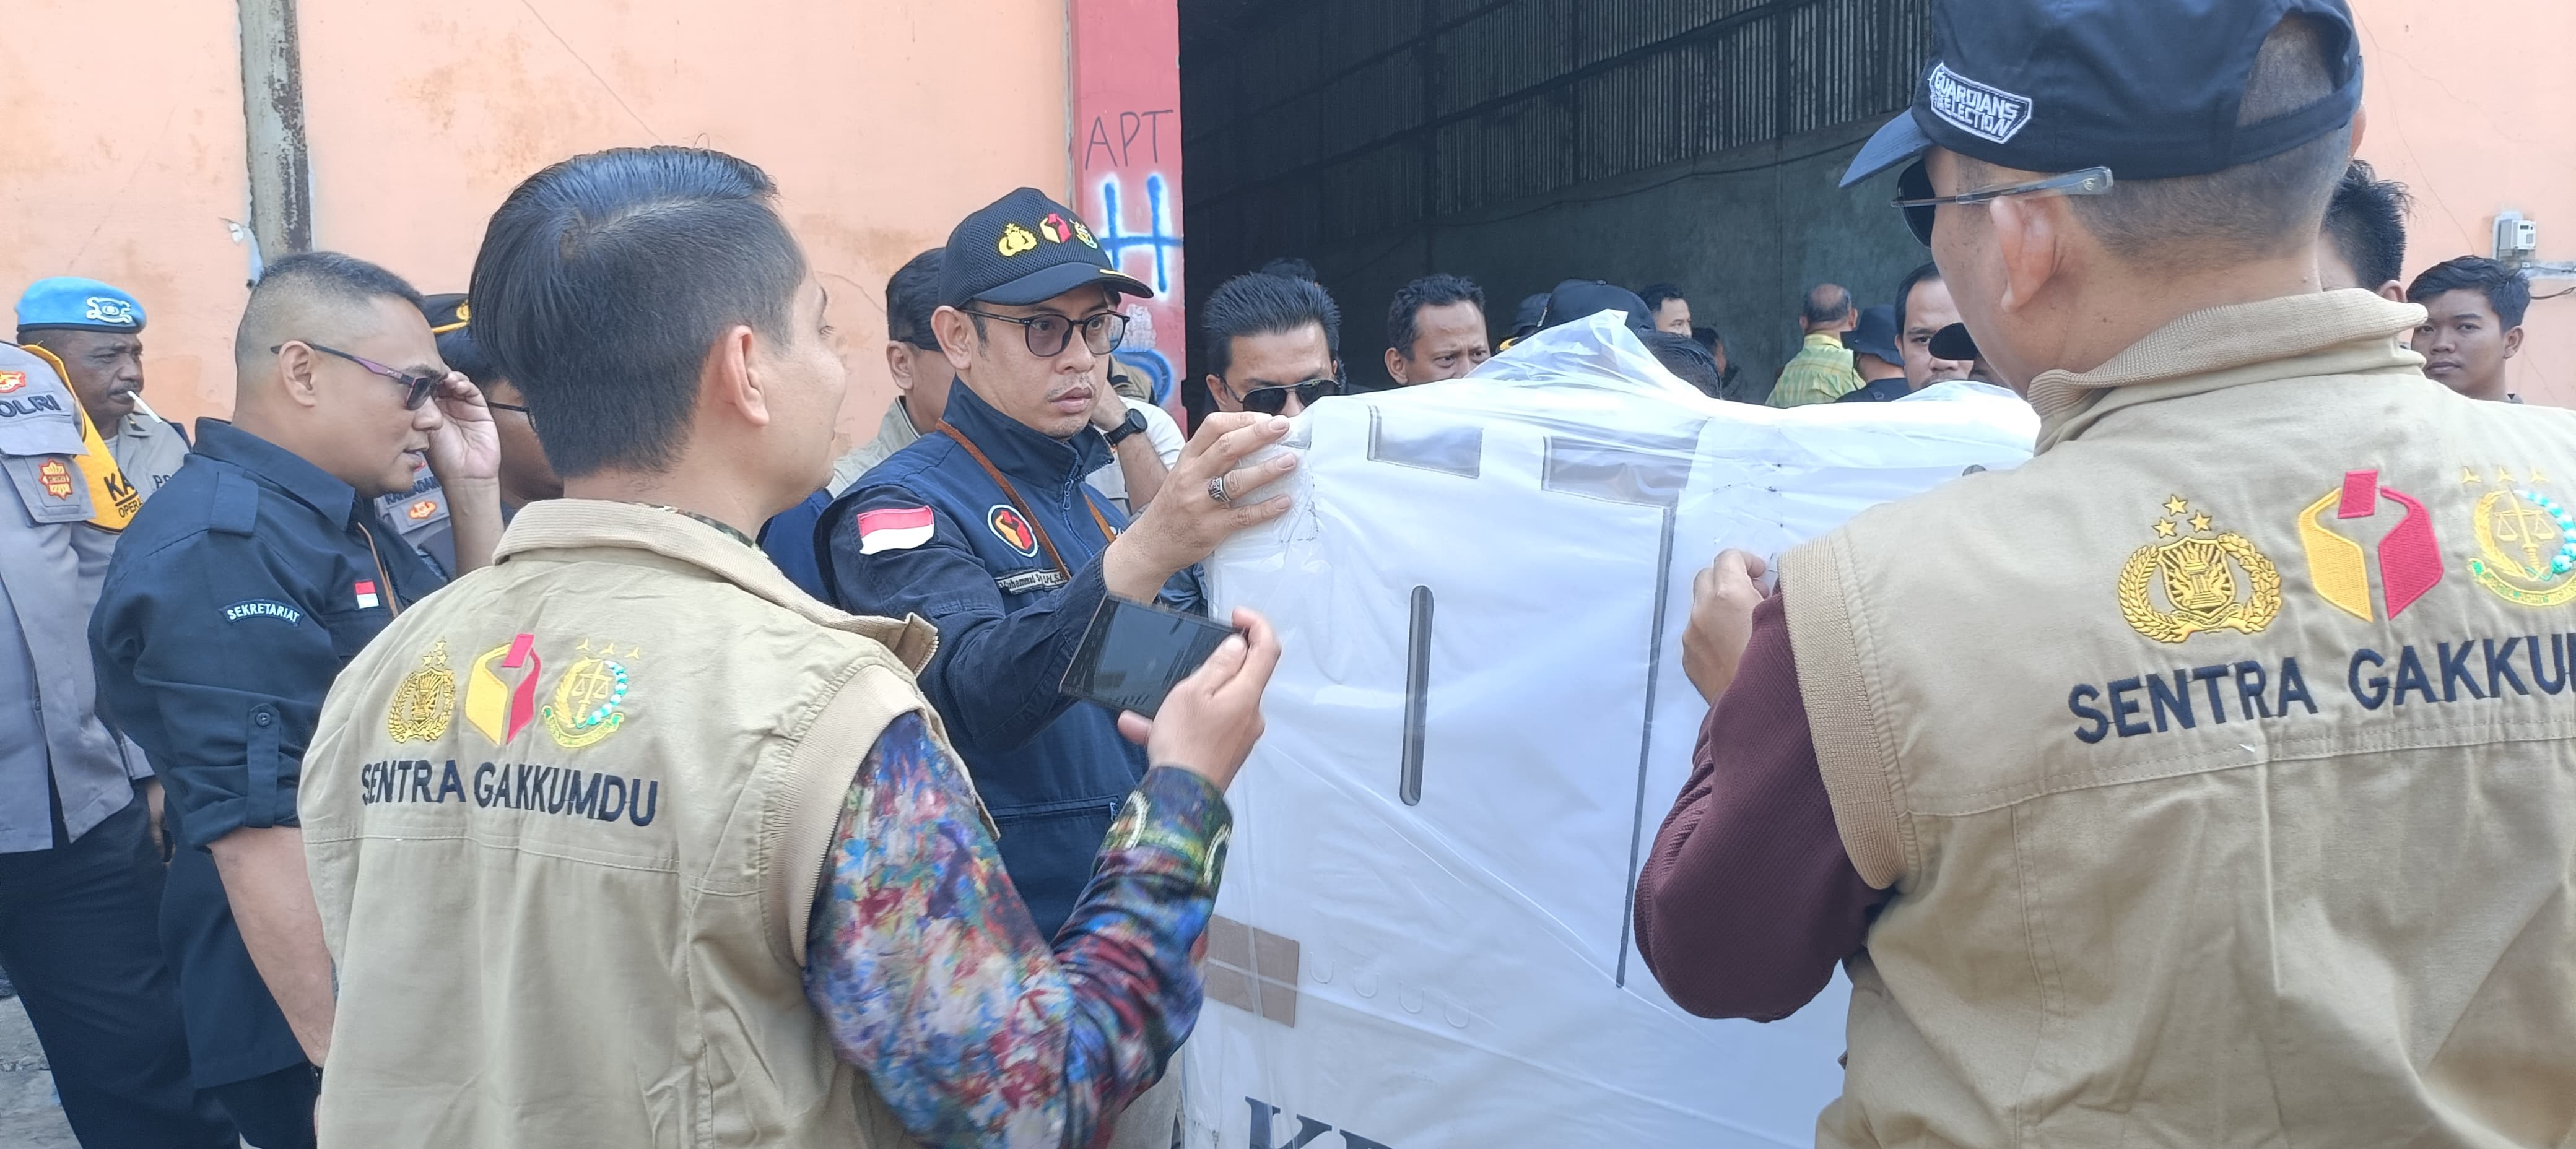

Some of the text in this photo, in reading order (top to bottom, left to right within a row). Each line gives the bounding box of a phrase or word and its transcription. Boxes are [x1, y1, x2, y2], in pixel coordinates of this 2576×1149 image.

[1934, 71, 2020, 121] GUARDIANS
[1085, 109, 1174, 170] APT
[227, 603, 300, 622] SEKRETARIAT
[2068, 631, 2576, 744] SENTRA GAKKU
[362, 759, 658, 827] SENTRA GAKKUMDU
